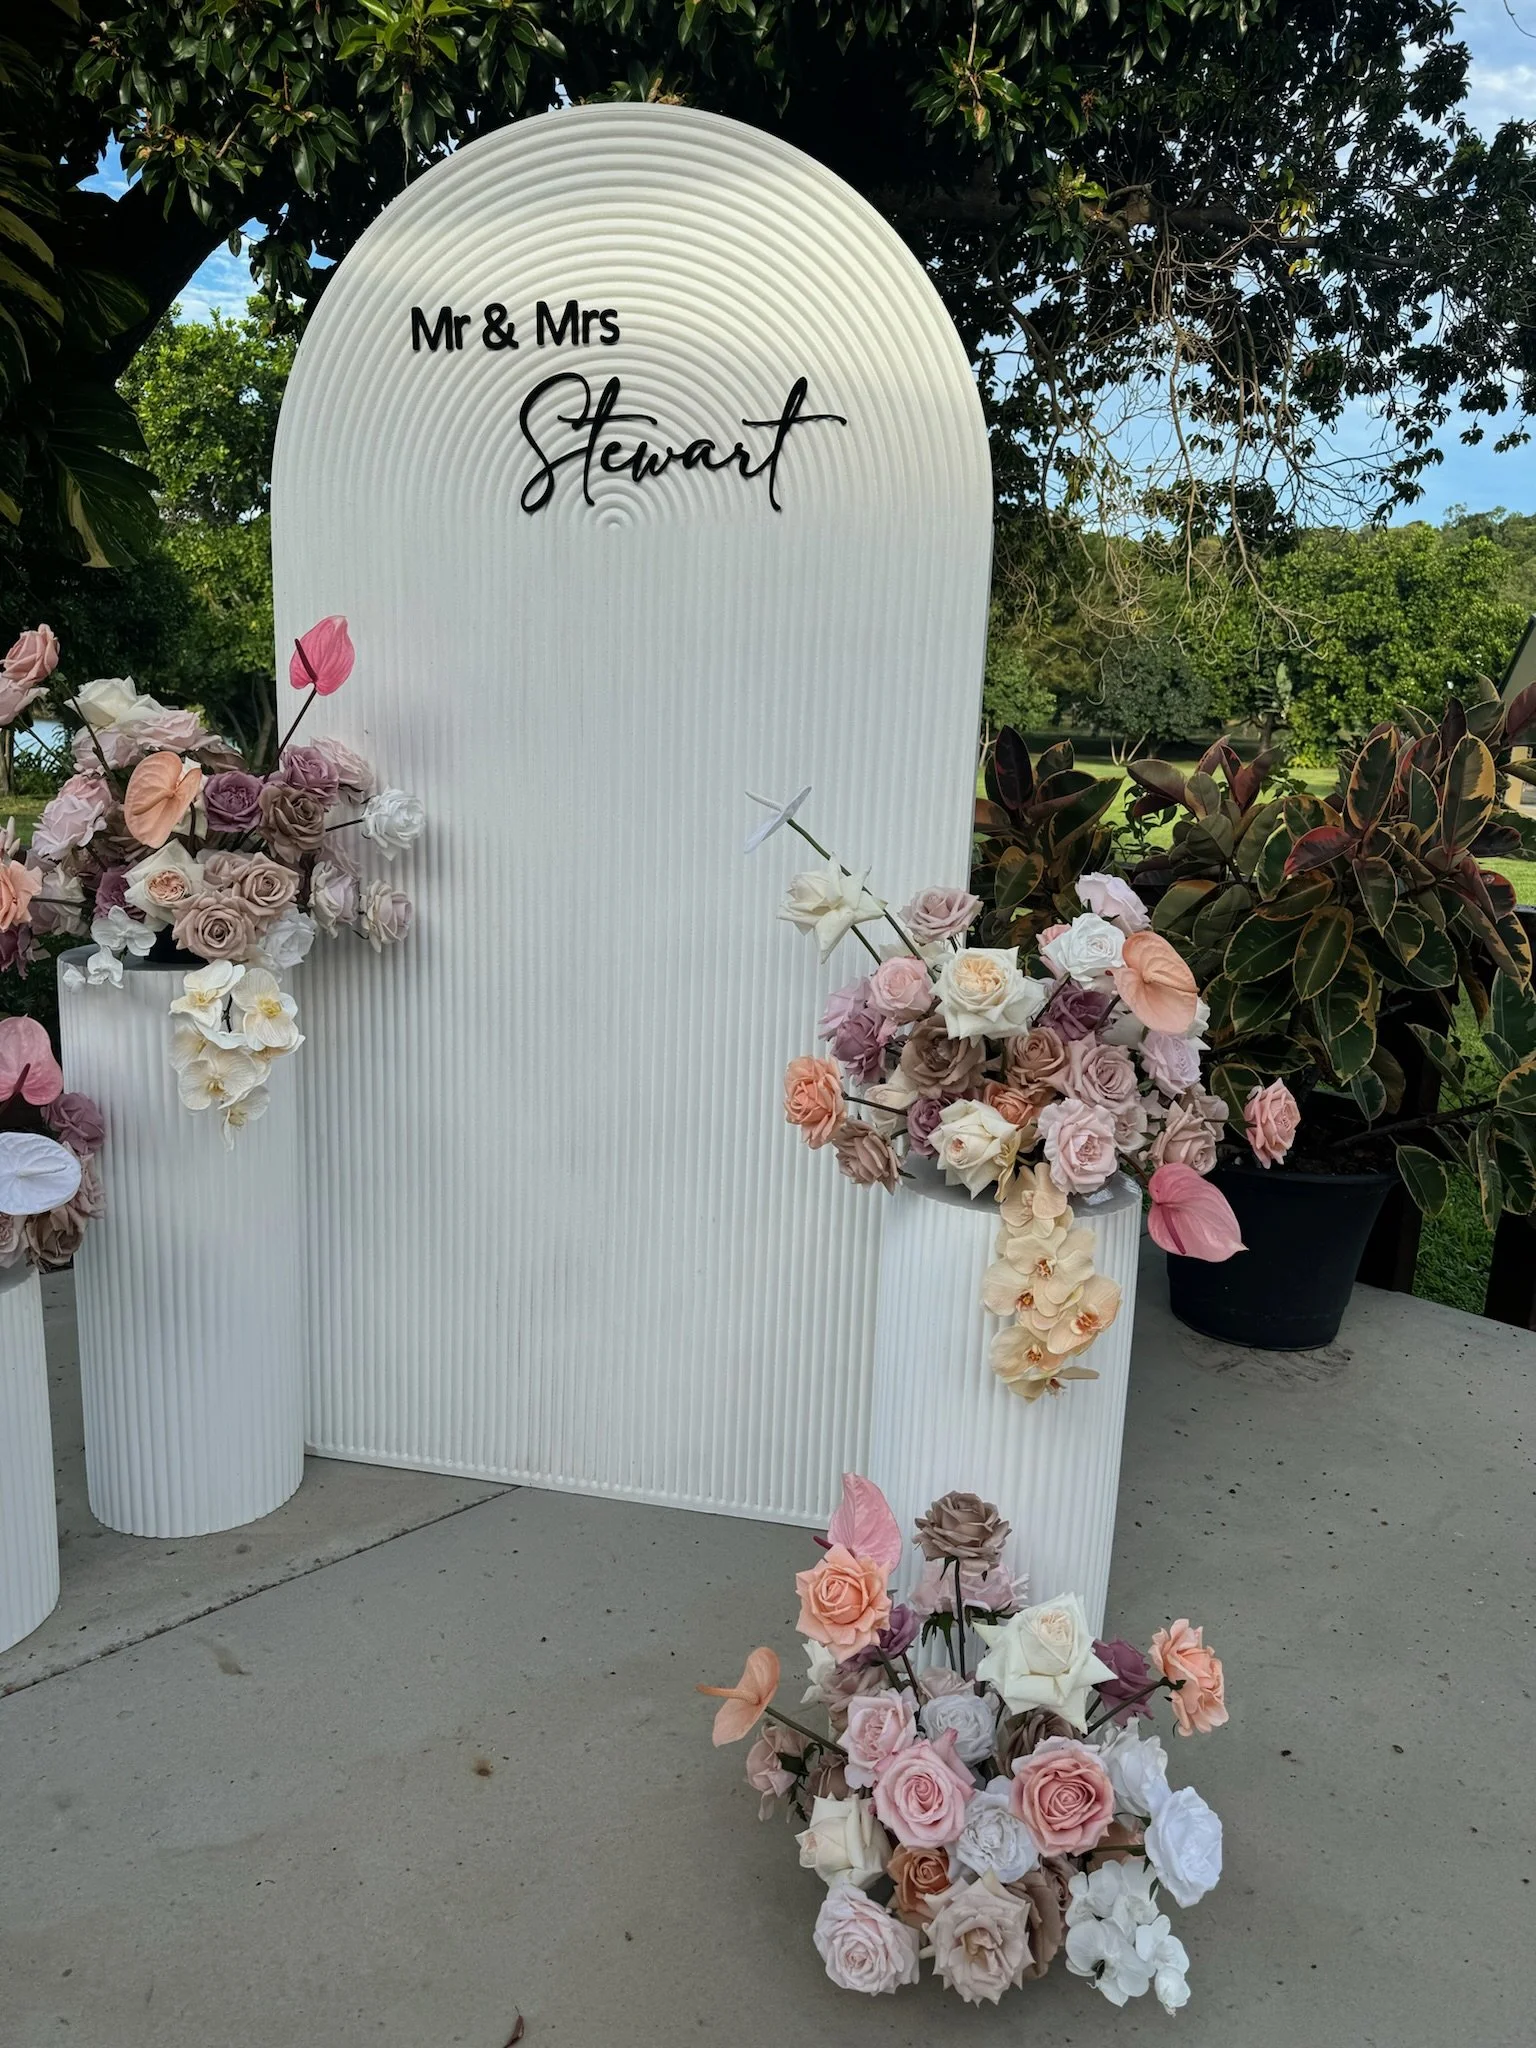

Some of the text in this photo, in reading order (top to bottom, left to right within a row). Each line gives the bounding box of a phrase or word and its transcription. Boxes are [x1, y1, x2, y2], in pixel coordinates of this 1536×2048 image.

[411, 299, 620, 352] Mr & Mrs
[518, 371, 848, 515] Stewart
